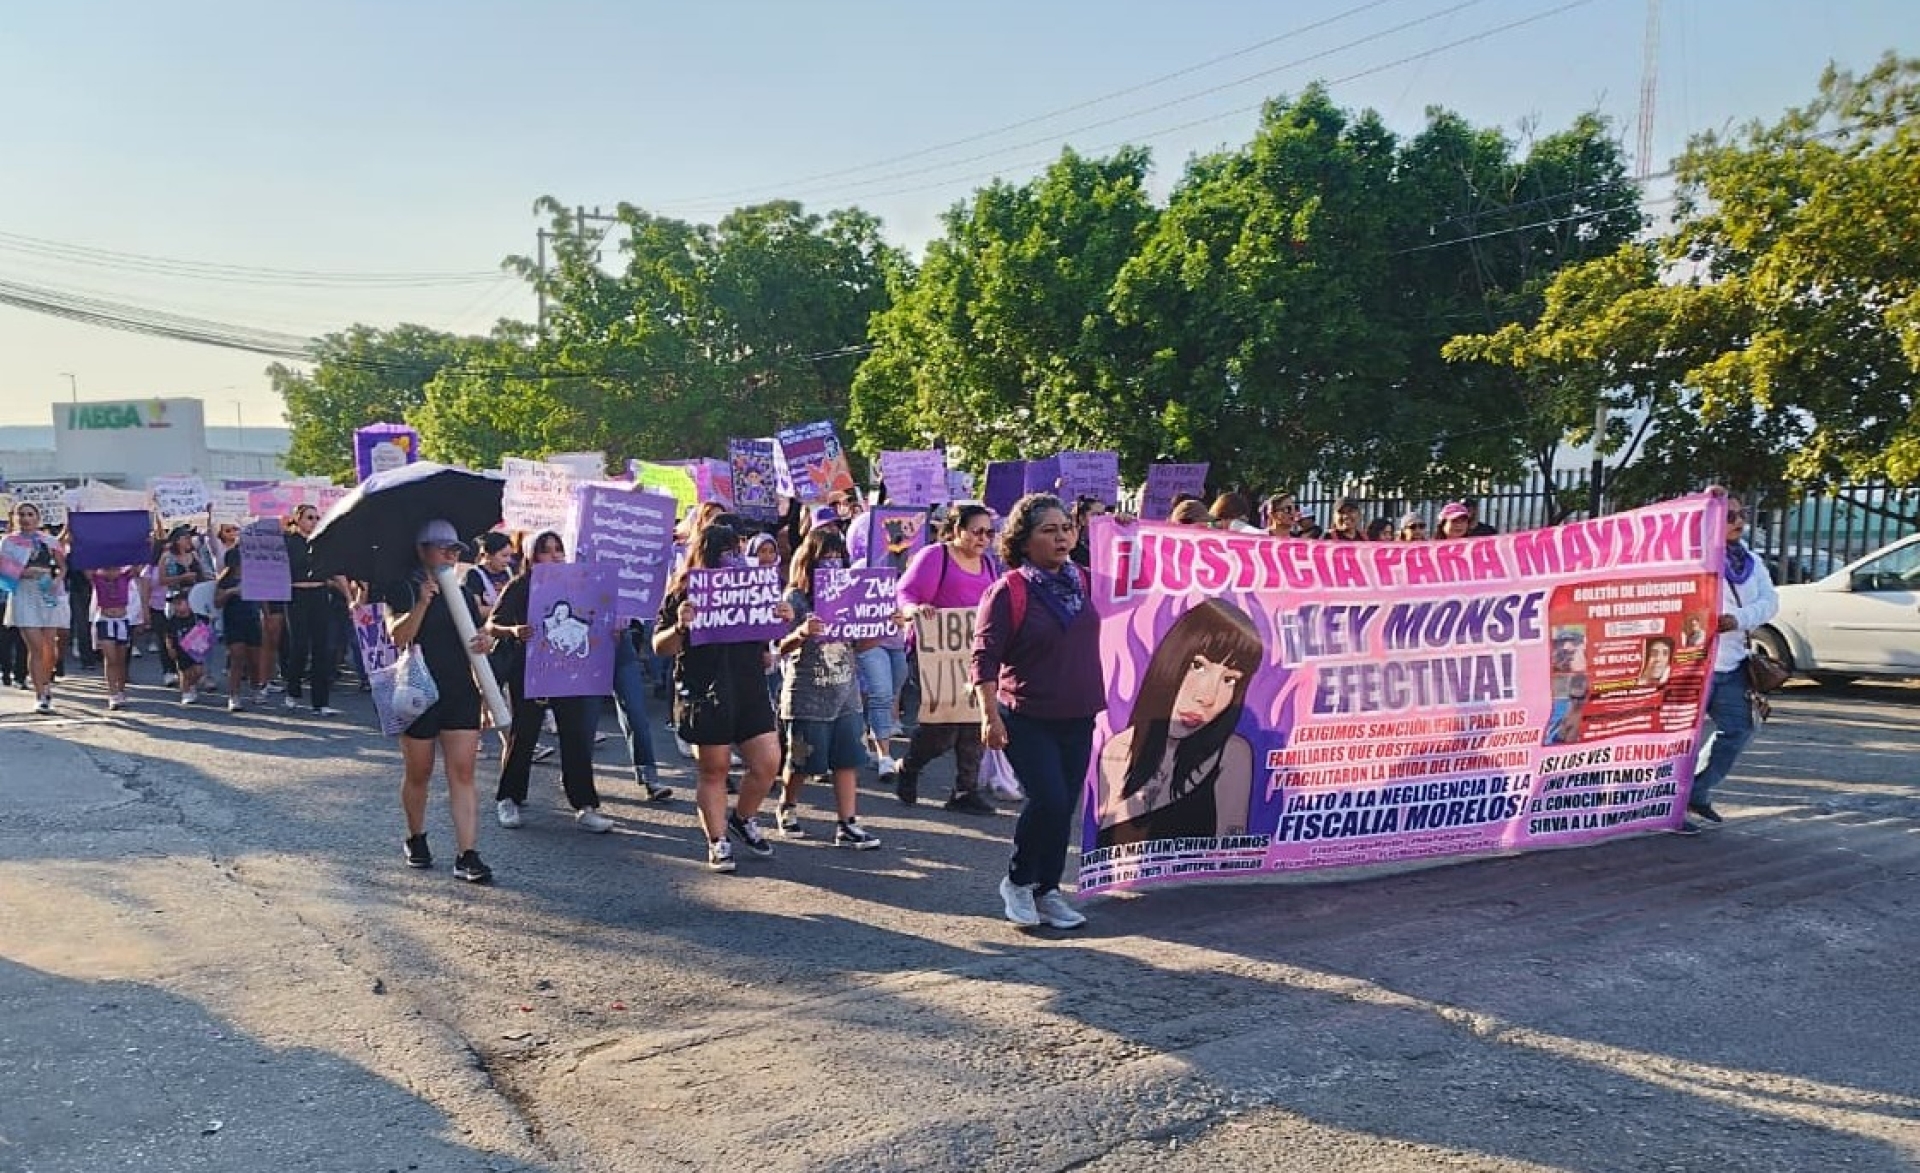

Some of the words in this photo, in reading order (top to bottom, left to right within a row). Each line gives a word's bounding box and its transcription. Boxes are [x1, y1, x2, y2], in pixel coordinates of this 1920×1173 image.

[1114, 534, 1366, 598] ¡JUSTICIA
[1374, 539, 1505, 587] PARA
[1514, 510, 1704, 576] MAYLIN!
[690, 575, 708, 588] NI
[1620, 585, 1635, 598] DE
[712, 586, 781, 606] SUMISAS
[1383, 591, 1546, 650] MONSE
[1588, 605, 1611, 618] POR
[843, 621, 897, 638] QUIERO
[914, 611, 977, 651] LIBR
[1312, 653, 1514, 714] EFECTIVA!
[1469, 713, 1500, 731] PARA
[1503, 711, 1525, 727] LOS
[1269, 746, 1344, 767] FAMILIARES
[1349, 743, 1371, 760] QUE
[1471, 734, 1486, 750] LA
[1561, 752, 1585, 769] LOS
[1587, 747, 1611, 764] VES
[1371, 764, 1386, 780] LA
[1429, 757, 1452, 774] DEL
[1566, 768, 1654, 788] PERMITAMOS
[1287, 792, 1335, 813] ¡ALTO
[1339, 791, 1351, 808] A
[1356, 788, 1376, 808] LA
[1379, 780, 1487, 805] NEGLIGENCIA
[1489, 777, 1510, 794] DE
[1513, 774, 1531, 791] LA
[1531, 799, 1541, 814] EL
[1545, 790, 1643, 811] CONOCIMIENTO
[1278, 806, 1399, 842] FISCALIA
[1403, 794, 1528, 832] MORELOS!
[1529, 815, 1568, 834] SIRVA
[1571, 814, 1580, 829] A
[1583, 812, 1598, 828] LA
[1176, 836, 1217, 851] CHINO
[1220, 834, 1270, 850] RAMOS
